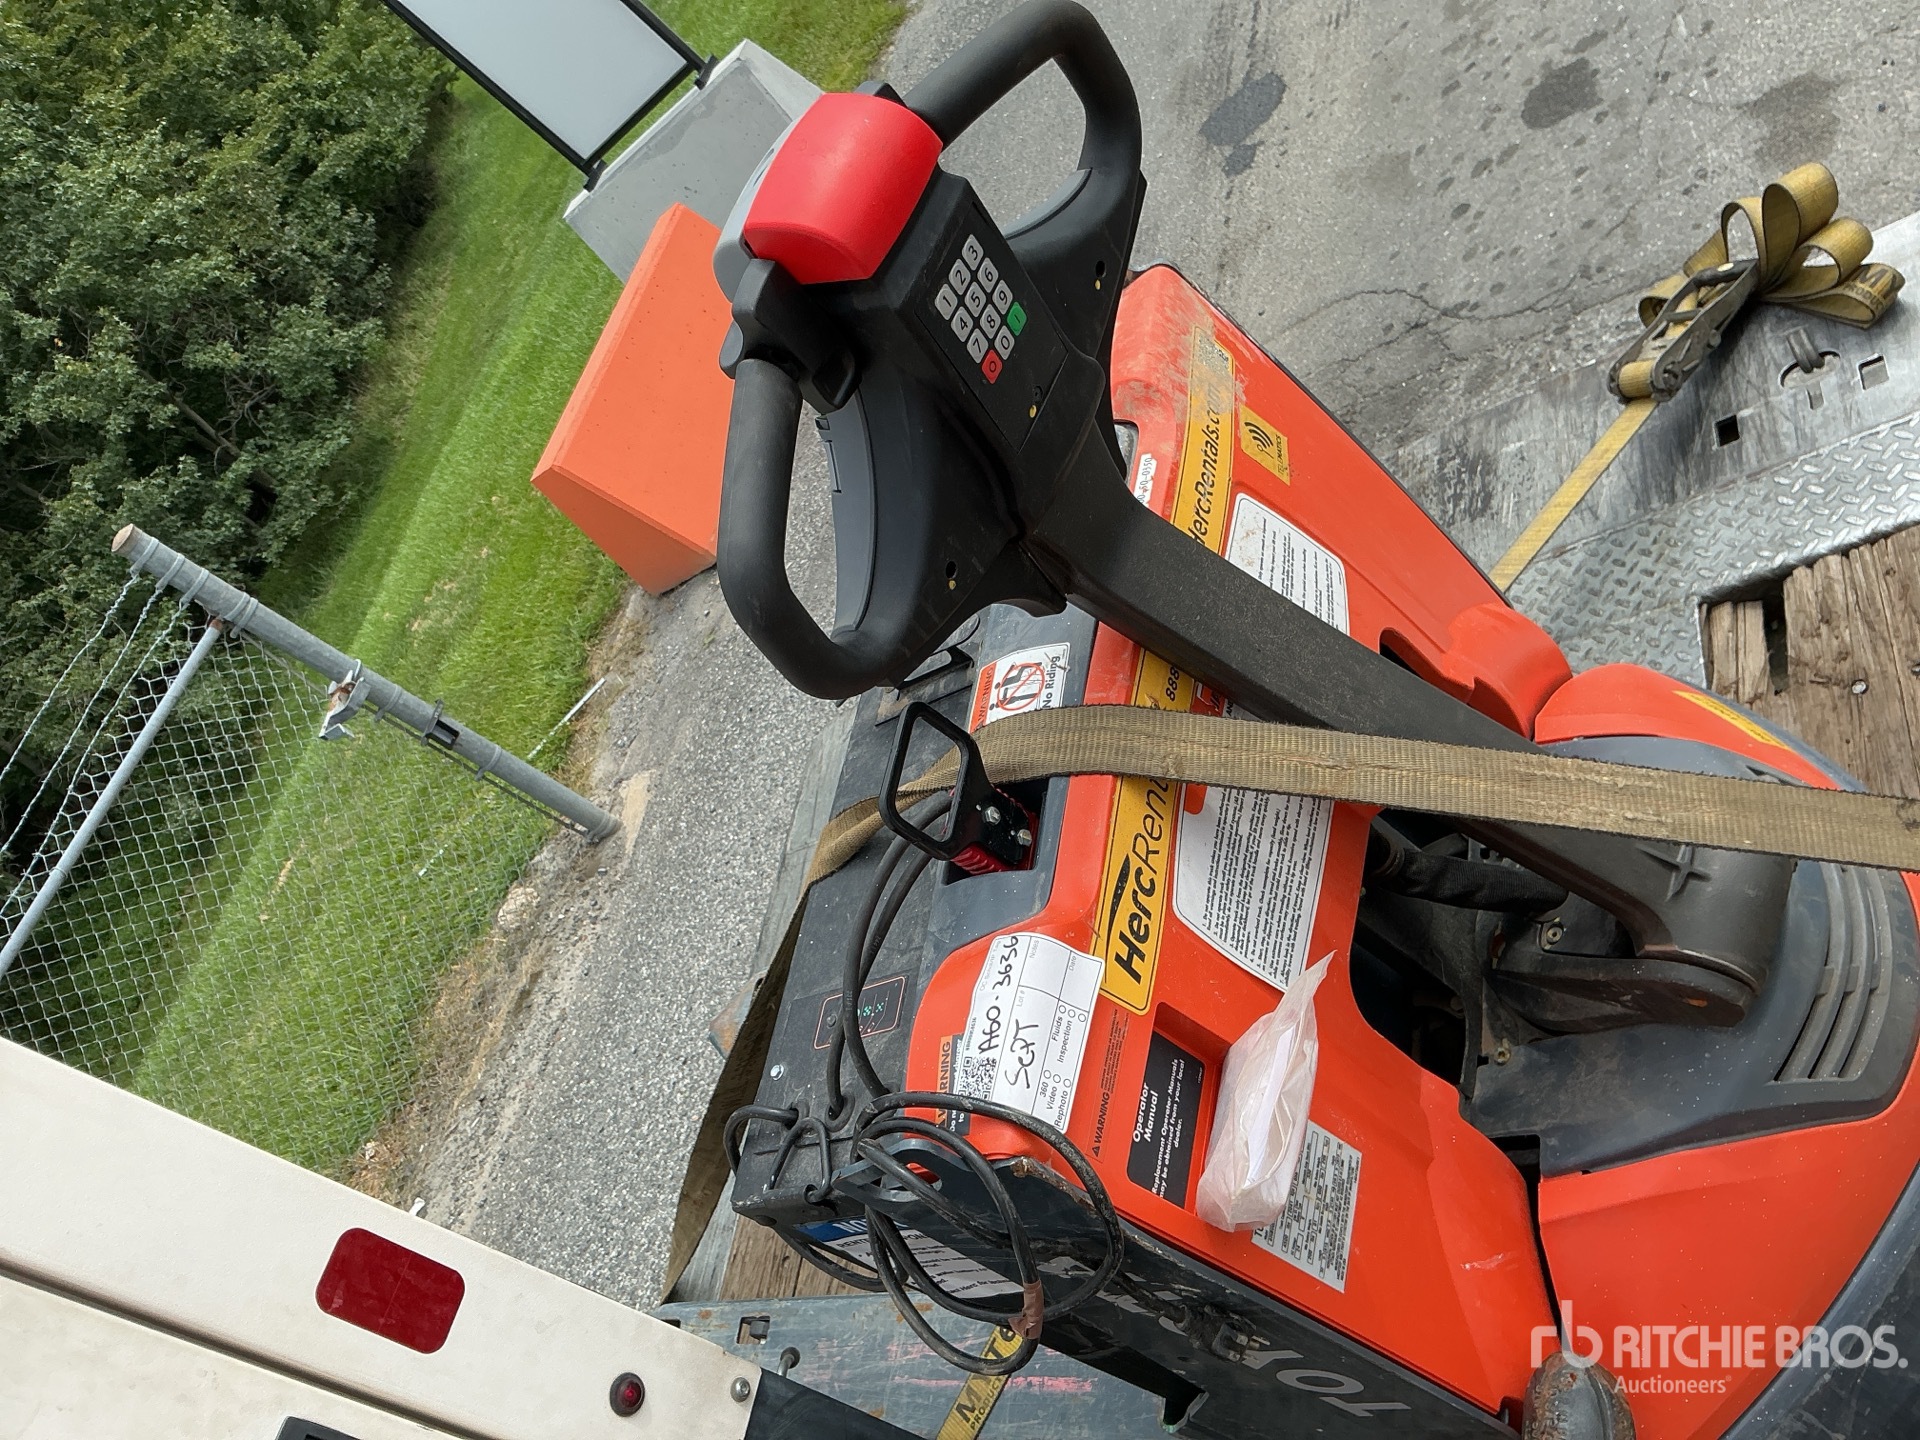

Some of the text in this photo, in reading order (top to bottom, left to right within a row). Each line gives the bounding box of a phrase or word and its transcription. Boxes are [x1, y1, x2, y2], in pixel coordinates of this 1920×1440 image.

[943, 245, 978, 307] 1 2 3
[960, 268, 993, 330] 4 5 6
[973, 292, 1008, 353] 7 8 9
[1277, 435, 1285, 475] TELEMATICS
[977, 668, 993, 722] WARNING
[1042, 656, 1060, 710] No Riding
[1029, 940, 1040, 959] Notes
[1069, 956, 1077, 971] Date
[1040, 1016, 1063, 1097] 360 Fluids
[1047, 1021, 1073, 1110] Video Inspection
[1055, 1090, 1069, 1127] Rephoto
[1133, 1083, 1149, 1143] Operator
[1145, 1091, 1159, 1142] Manual
[1171, 1101, 1179, 1126] from
[1175, 1081, 1183, 1101] your
[1093, 1093, 1111, 1144] WARNING
[1152, 1059, 1179, 1193] Replacement Operator Manuals
[1174, 1119, 1183, 1148] dealer.
[1164, 1125, 1174, 1164] obtained
[1162, 1166, 1168, 1178] be
